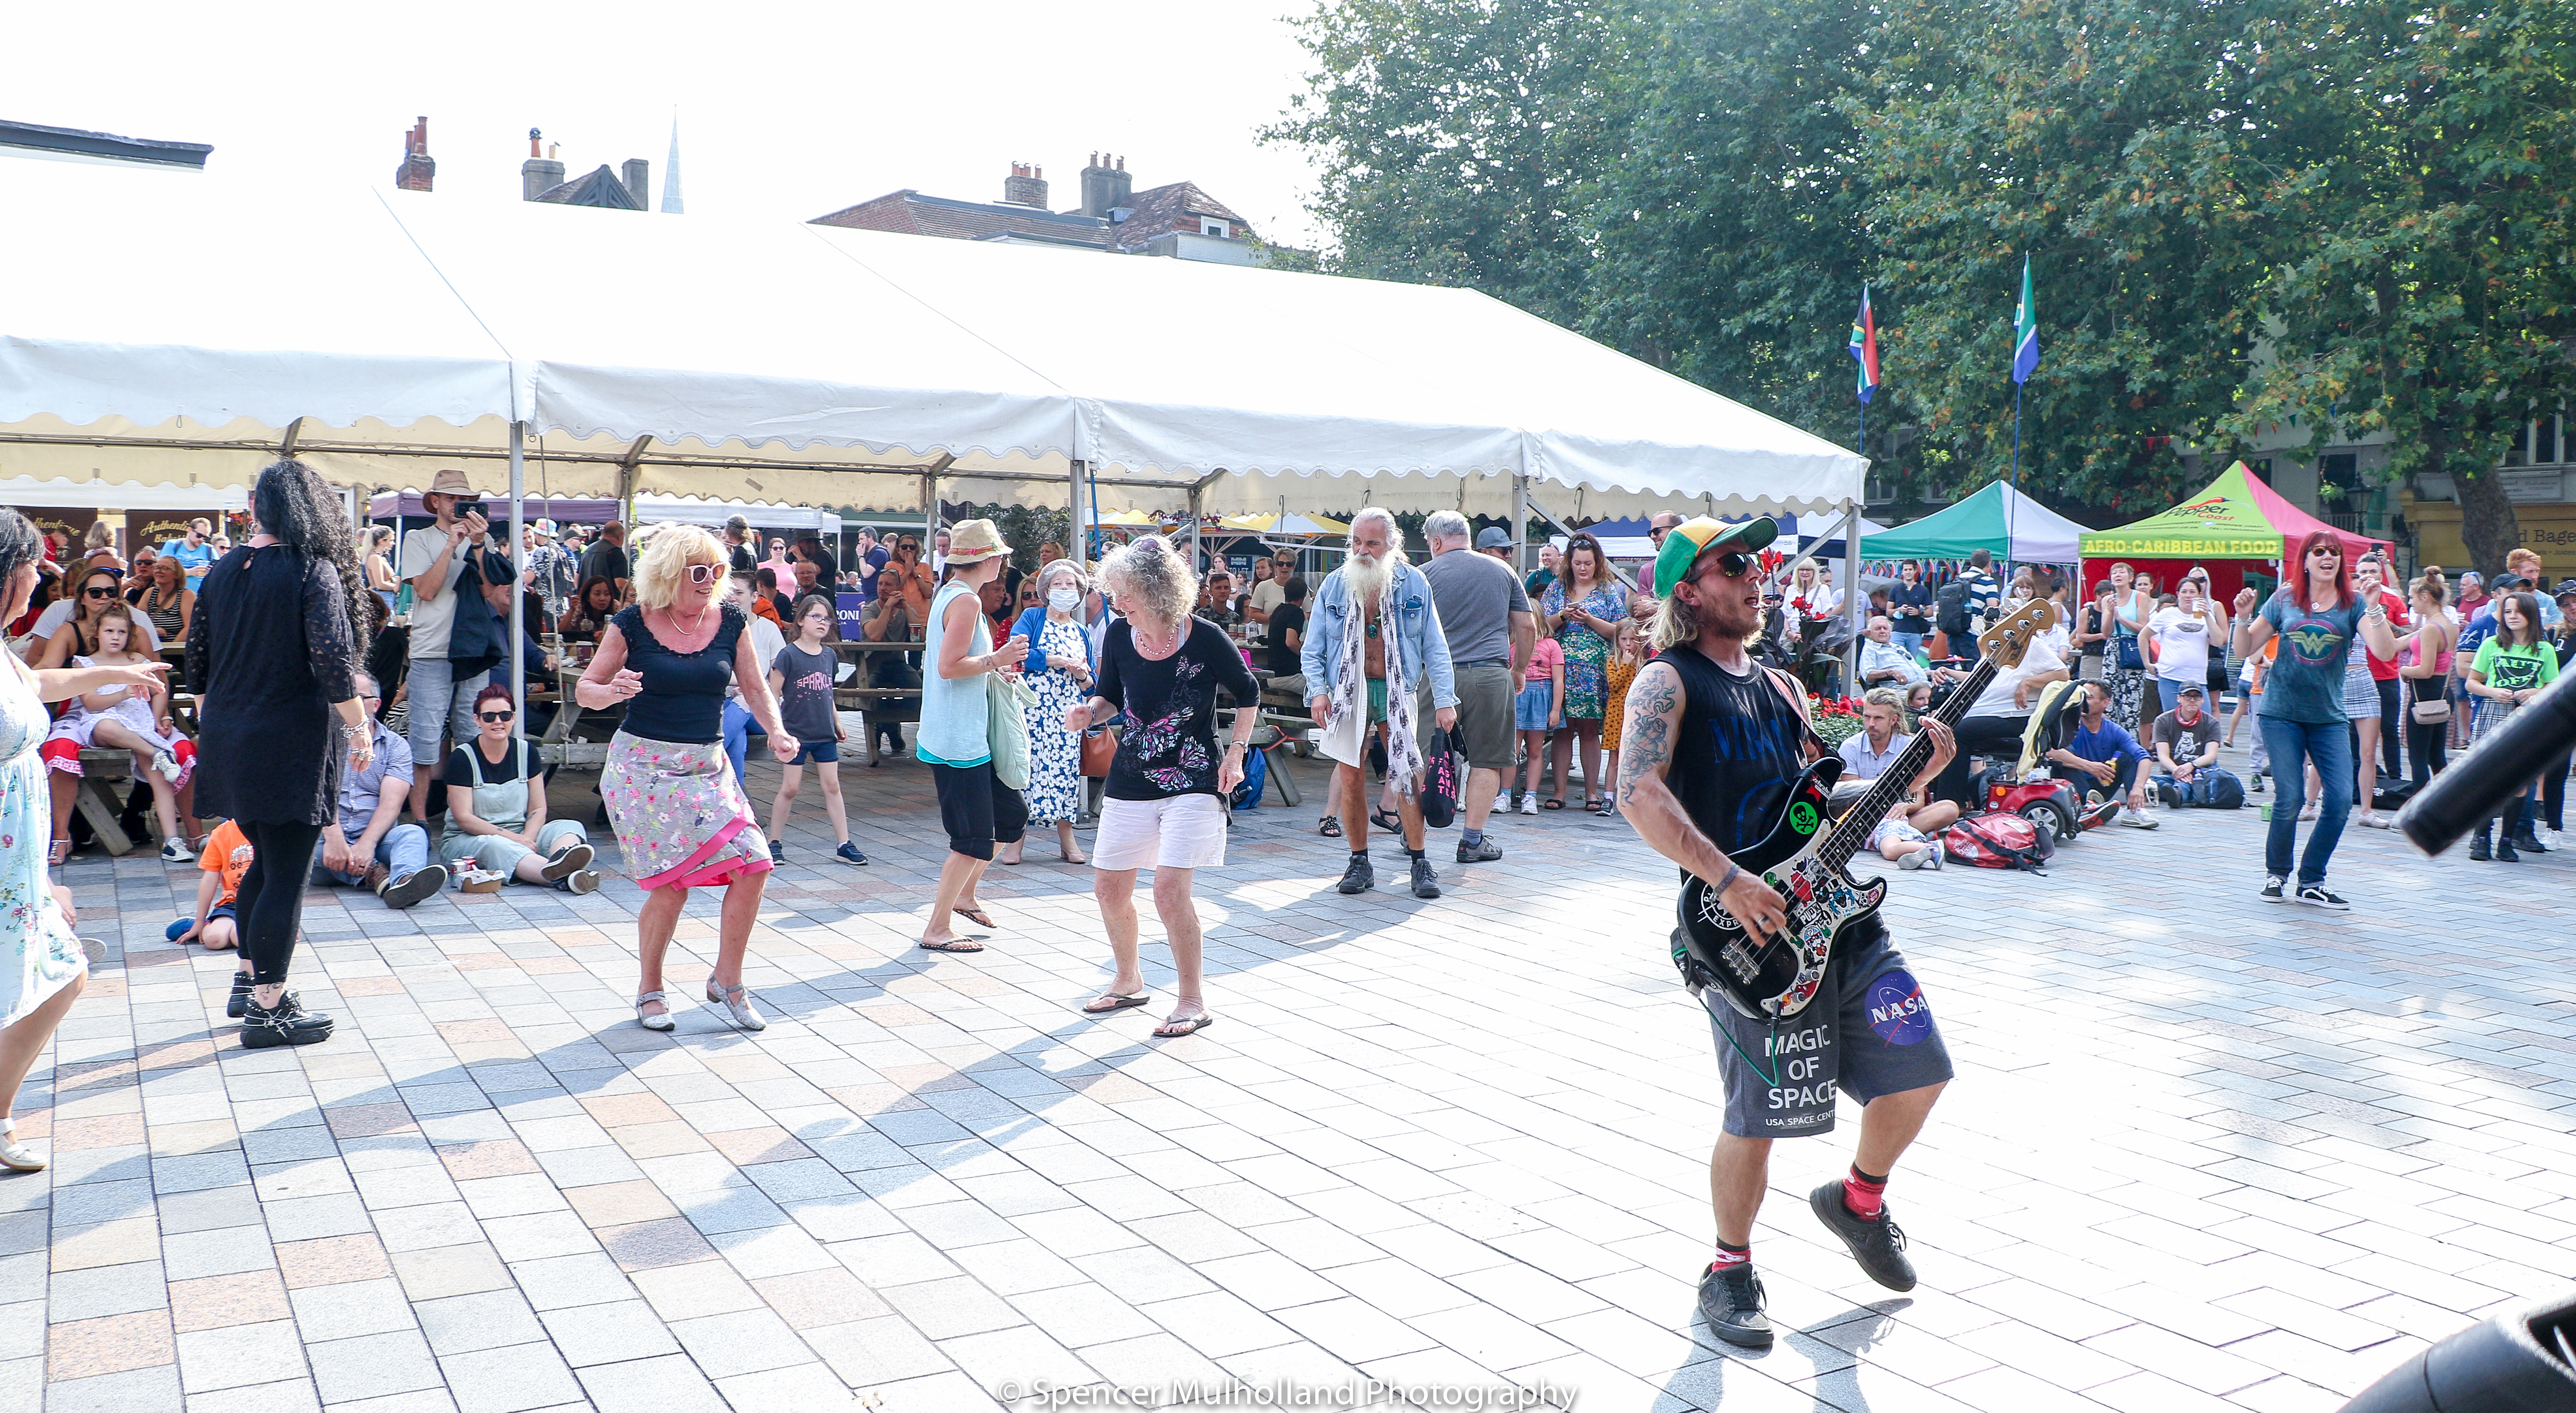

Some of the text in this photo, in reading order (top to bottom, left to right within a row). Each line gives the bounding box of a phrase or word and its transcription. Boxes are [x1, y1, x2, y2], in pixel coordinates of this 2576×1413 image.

[2198, 511, 2234, 521] Coast
[141, 520, 189, 536] Authenti
[2085, 540, 2278, 554] AFRO-CARIBBEAN FOOD
[797, 672, 832, 691] SPARKLE
[1871, 996, 1929, 1024] NASA
[1765, 1024, 1830, 1057] MAGIC
[1788, 1056, 1819, 1080] OF
[1768, 1078, 1836, 1109] SPACE
[1787, 1116, 1814, 1125] SPACE
